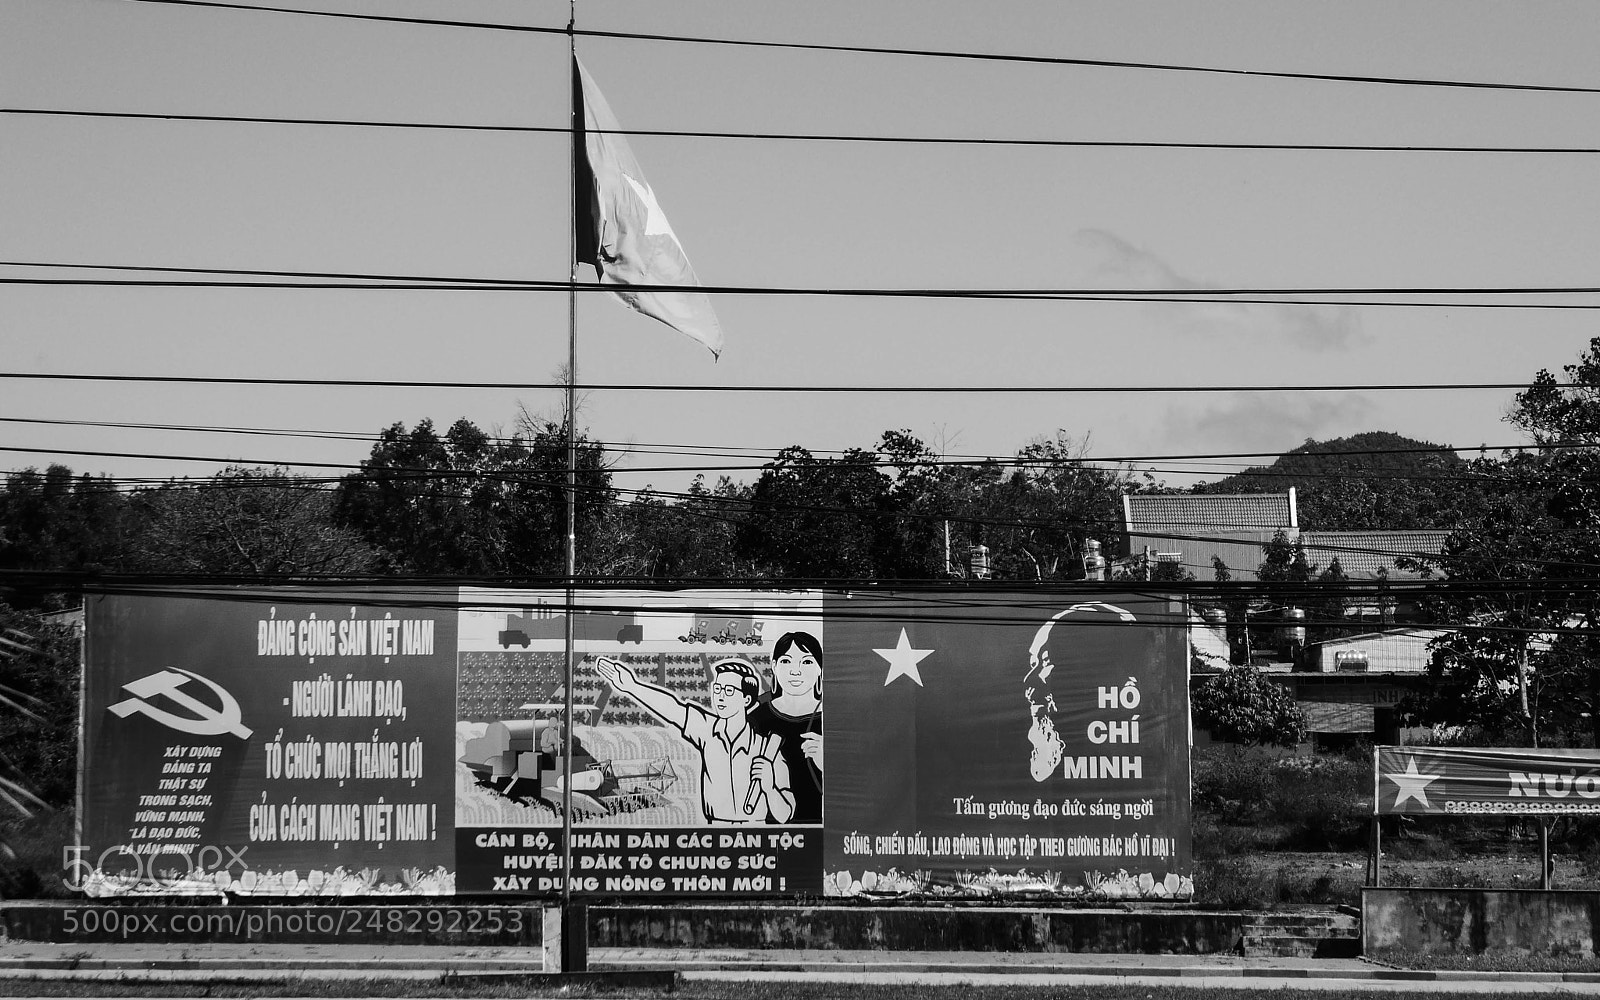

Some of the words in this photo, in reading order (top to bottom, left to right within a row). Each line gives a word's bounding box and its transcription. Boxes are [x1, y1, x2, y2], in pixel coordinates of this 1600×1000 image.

[257, 607, 295, 656] ĐẢNG
[298, 612, 336, 664] CỘNG
[338, 607, 367, 656] SẢN
[370, 612, 400, 664] VIỆT
[402, 619, 435, 656] NAM
[292, 672, 335, 717] NGƯỜI
[337, 674, 373, 717] LÃNH
[375, 680, 407, 725] ĐẠO,
[1098, 677, 1141, 709] HỒ
[1087, 715, 1140, 744] CHÍ
[163, 745, 188, 758] XÂY
[188, 745, 222, 760] DỰNG
[265, 727, 284, 779] TỔ
[284, 734, 322, 780] CHỨC
[324, 741, 351, 787] MỌI
[354, 728, 399, 779] THẮNG
[401, 736, 423, 787] LỢI
[162, 759, 196, 774] ĐẢNG
[197, 763, 212, 774] TA
[1063, 756, 1142, 779] MINH
[158, 777, 187, 792] THẬT
[188, 777, 208, 792] SỰ
[138, 795, 177, 806] TRONG
[179, 795, 213, 808] SẠCH,
[953, 795, 985, 815] Tấm
[988, 800, 1031, 820] gương
[1033, 798, 1058, 820] đạo
[1061, 798, 1087, 816] đức
[1089, 798, 1122, 820] sáng
[1124, 798, 1154, 820] ngời
[135, 809, 166, 823] VỮNG
[167, 811, 206, 824] MẠNH,
[249, 791, 277, 842] CỦA
[279, 796, 317, 842] CÁCH
[319, 803, 360, 850] MẠNG
[363, 796, 393, 850] VIỆT
[395, 803, 428, 841] NAM
[149, 827, 173, 841] ĐẠO
[174, 826, 202, 839] ĐỨC,
[475, 832, 516, 849] CÁN
[522, 832, 556, 851] BỘ,
[627, 832, 669, 849] DÂN
[676, 832, 714, 849] CÁC
[719, 832, 762, 849] DÂN
[768, 833, 805, 851] TỘC
[843, 830, 873, 857] SỐNG,
[875, 830, 905, 855] CHIẾN
[907, 830, 930, 858] ĐẤU,
[932, 836, 951, 856] LAO
[952, 833, 980, 859] ĐỘNG
[982, 833, 995, 856] VÀ
[997, 837, 1017, 860] HỌC
[1019, 834, 1037, 860] TẬP
[1039, 838, 1064, 857] THEO
[1102, 834, 1122, 857] BÁC
[1125, 832, 1139, 857] HỒ
[1140, 835, 1150, 857] VĨ
[1152, 837, 1169, 860] ĐẠI
[580, 853, 623, 870] ĐĂK
[628, 853, 654, 870] TÔ
[659, 855, 732, 870] CHUNG
[737, 852, 776, 870] SỨC
[492, 875, 532, 891] XÂY
[605, 875, 666, 891] NÔNG
[672, 875, 726, 891] THÔN
[732, 874, 773, 891] MỚI
